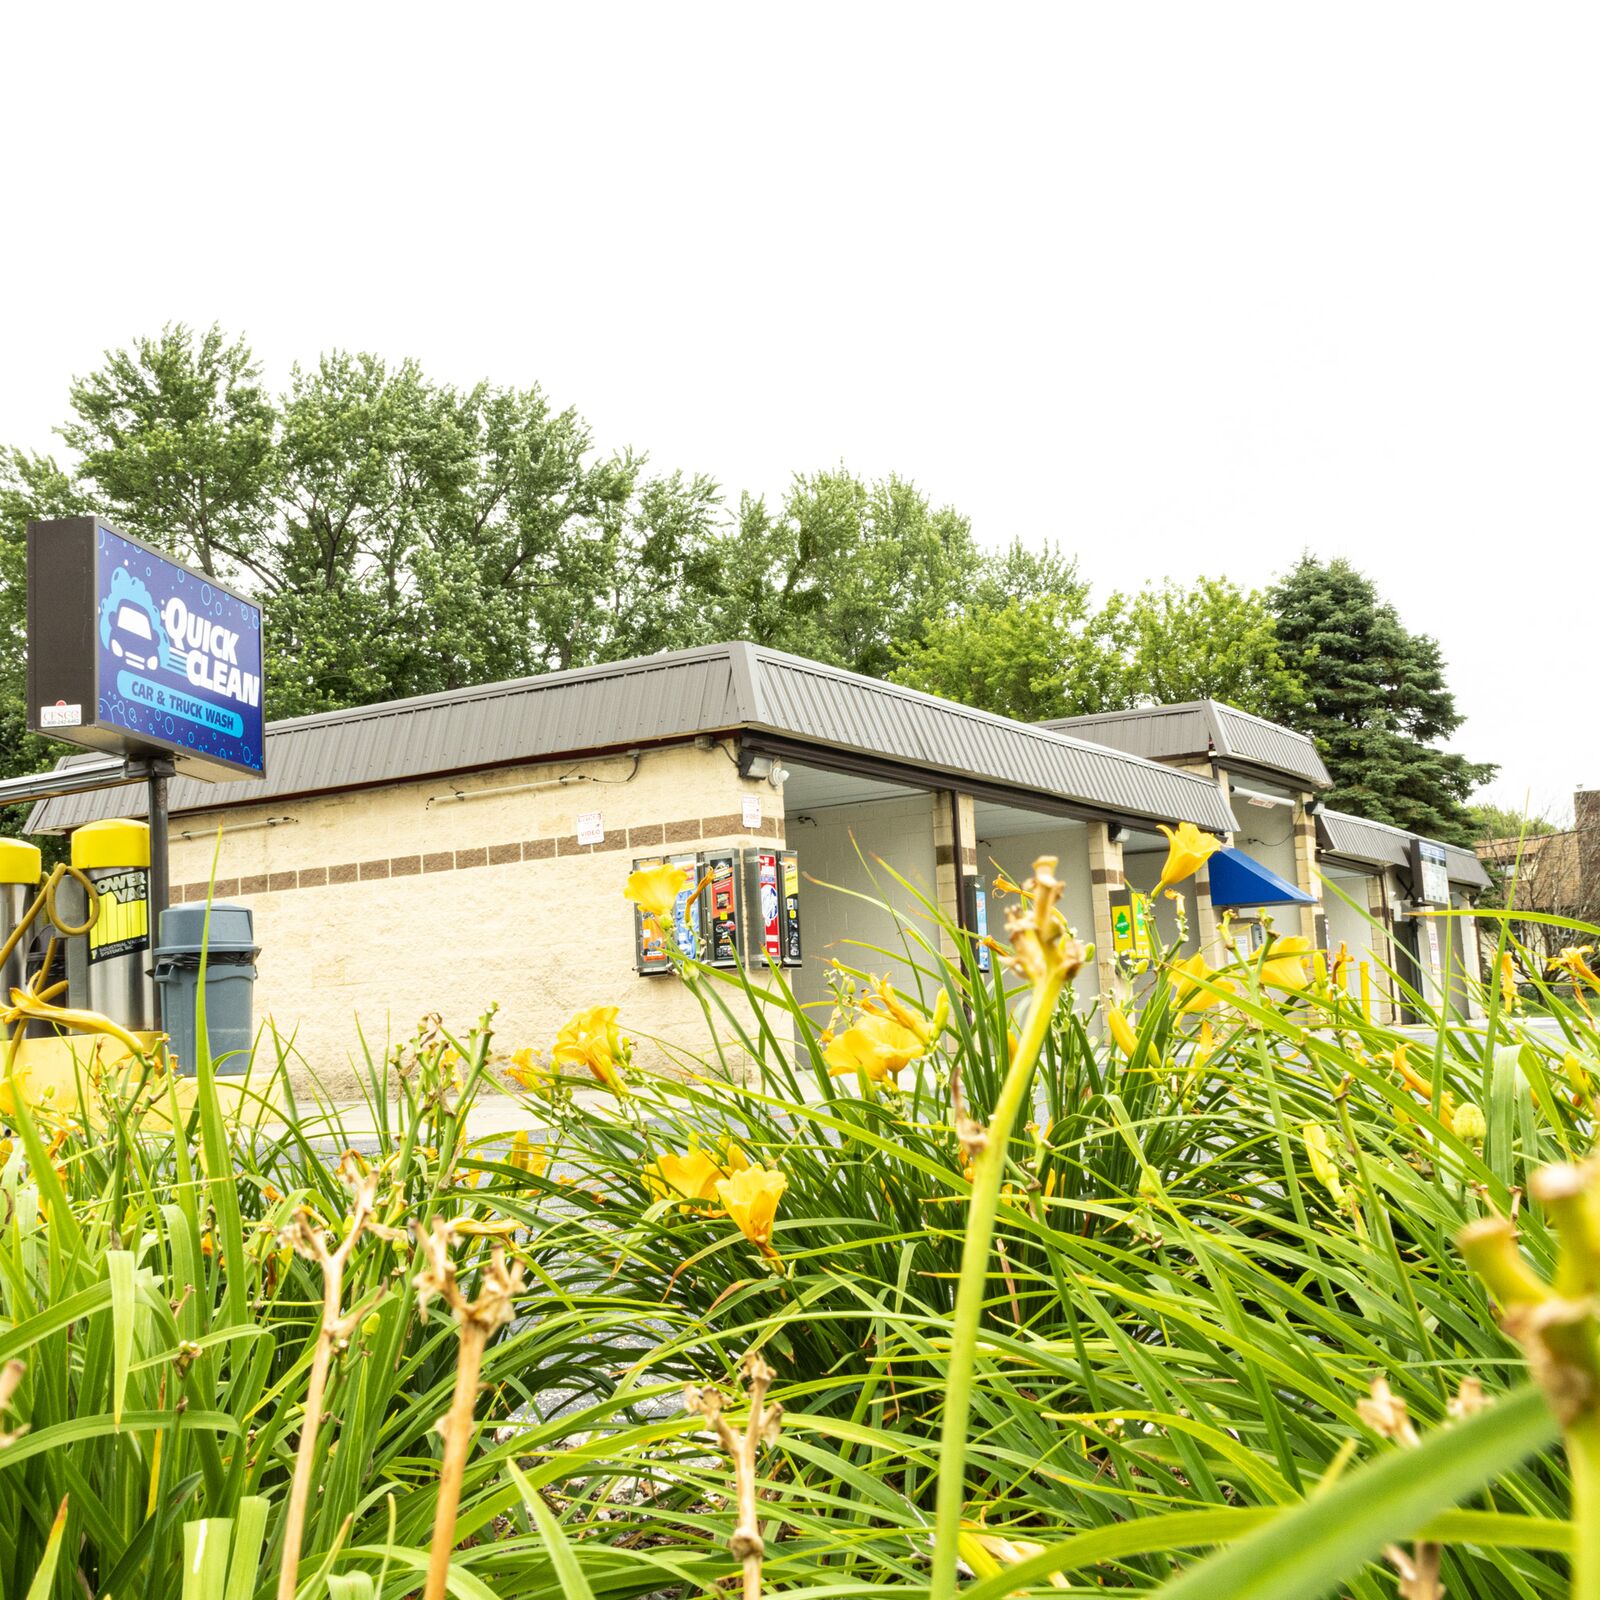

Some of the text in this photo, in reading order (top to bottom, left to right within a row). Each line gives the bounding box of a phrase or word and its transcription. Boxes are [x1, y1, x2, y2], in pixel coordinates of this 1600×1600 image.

[165, 597, 239, 665] QUICK
[186, 650, 260, 707] CLEAN
[131, 681, 234, 731] CAR & TRUCK WASH
[94, 871, 147, 894] OWER
[113, 885, 147, 904] VAC
